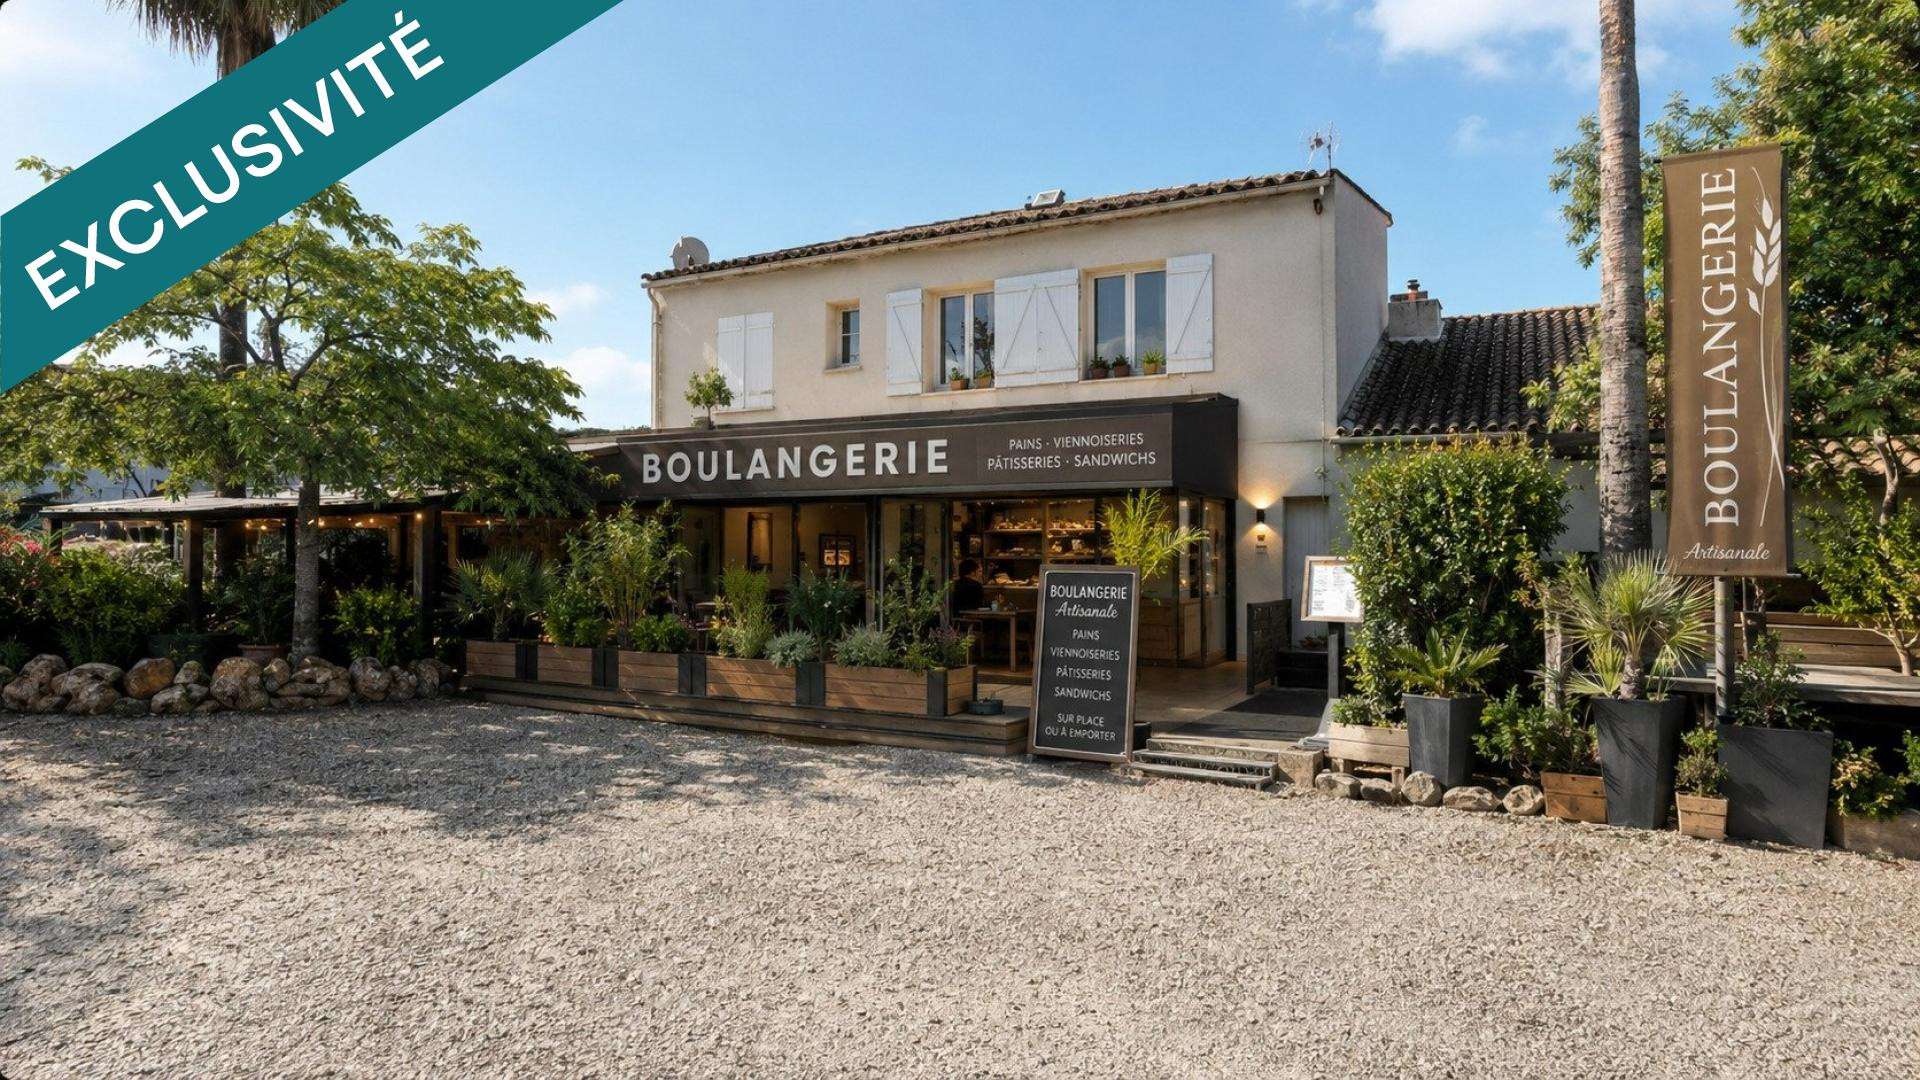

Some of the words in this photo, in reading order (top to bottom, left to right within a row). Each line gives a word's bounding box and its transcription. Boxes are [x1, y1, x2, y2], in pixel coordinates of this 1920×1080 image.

[1701, 167, 1739, 526] BOULANGERIE
[1009, 437, 1042, 451] PAINS
[1053, 432, 1144, 450] VIENNOISERIES
[642, 439, 949, 484] BOULANGERIE
[987, 453, 1061, 471] PÂTISSERIES
[1074, 451, 1157, 468] SANDWICHS
[1683, 542, 1770, 561] Artisanale
[1050, 584, 1128, 600] BOULANGERIE
[1055, 601, 1118, 618] Artisanale
[1072, 629, 1100, 640] PAINS
[1050, 647, 1120, 661] VIENNOISERIES
[1056, 666, 1112, 680] PÂTISSERIES
[1054, 686, 1112, 701] SANDWICHS
[1057, 713, 1074, 723] SUR
[1076, 715, 1104, 727] PLACE
[1045, 726, 1058, 737] OU
[1069, 730, 1116, 742] EMPORTER
